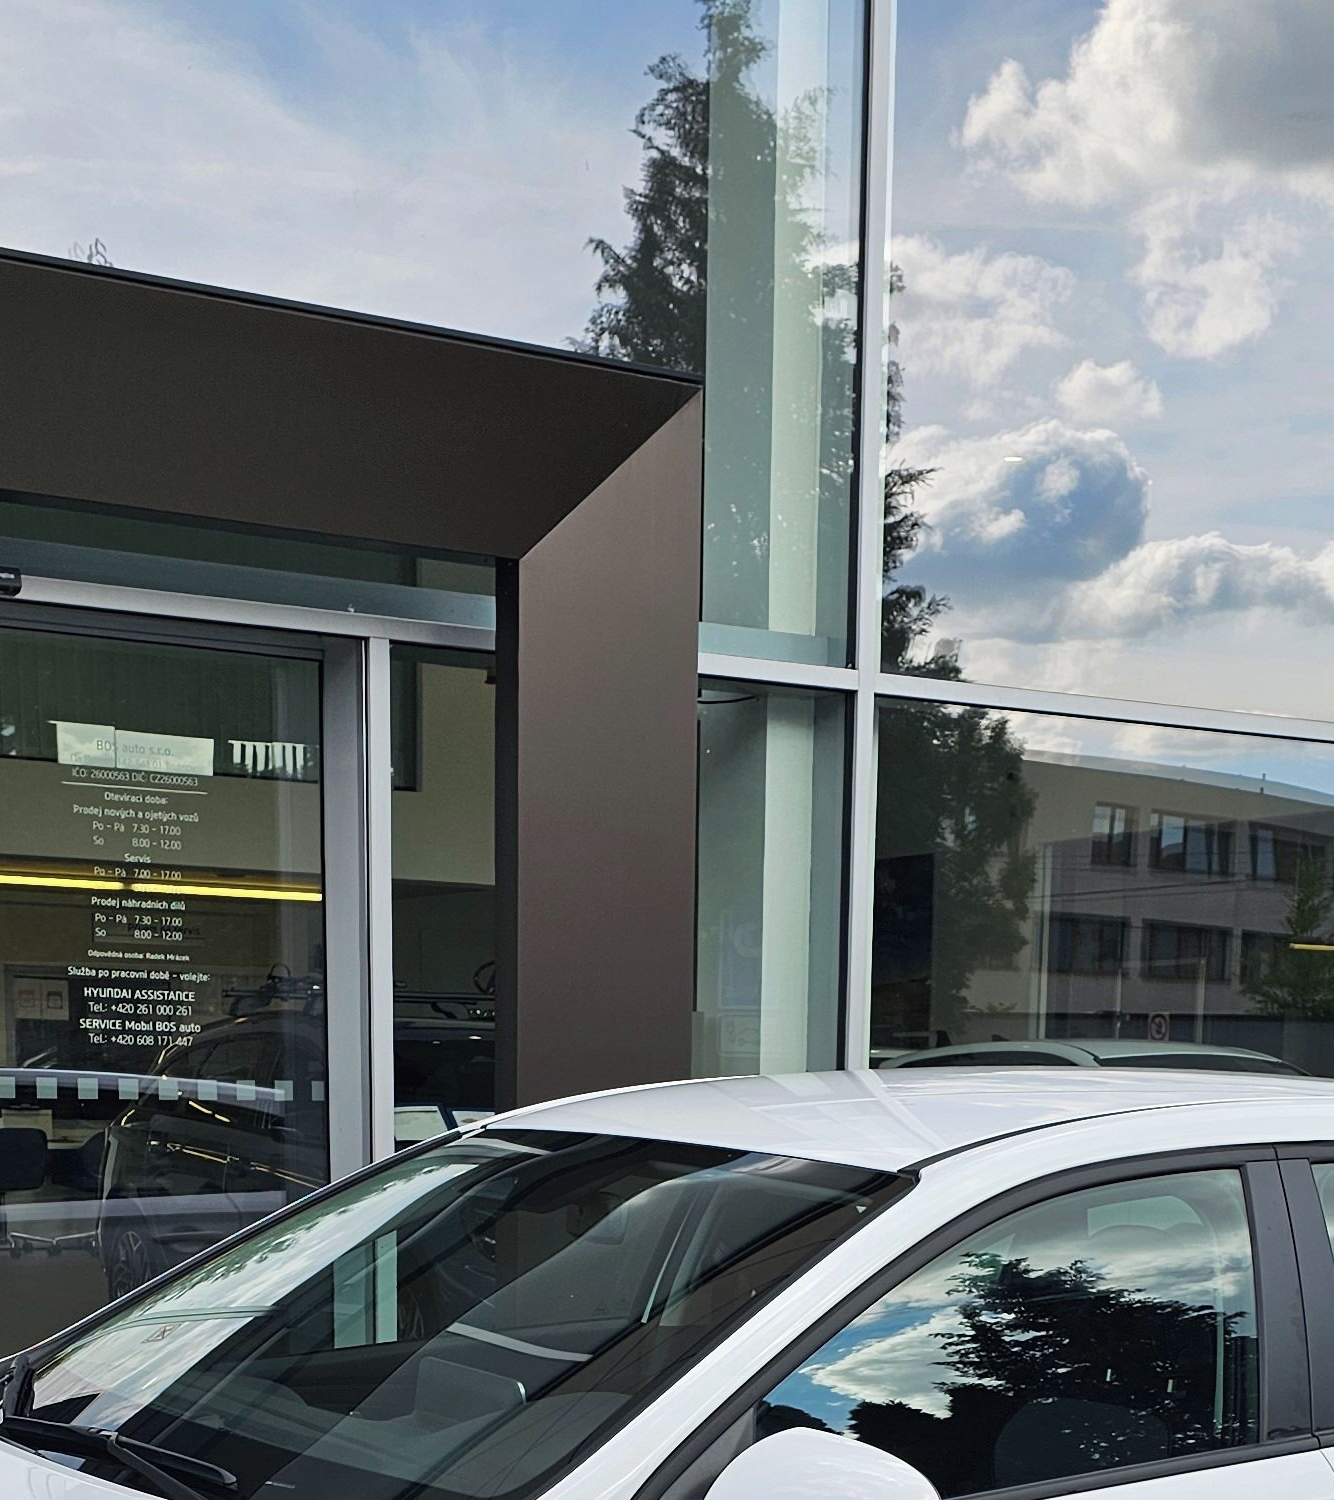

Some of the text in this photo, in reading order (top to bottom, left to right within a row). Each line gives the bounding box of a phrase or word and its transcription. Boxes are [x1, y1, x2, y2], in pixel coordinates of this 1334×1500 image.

[73, 804, 199, 822] Prodej nových a ojetých vozů
[92, 821, 104, 831] Po
[114, 822, 125, 832] Pá
[132, 823, 149, 834] 7.30
[160, 825, 181, 836] 17.00
[93, 835, 104, 845] So
[132, 838, 150, 848] 8.00
[160, 840, 181, 850] 12.00
[124, 853, 151, 863] Servis
[94, 866, 105, 876] Po
[115, 867, 126, 878] Pá
[133, 868, 151, 879] 7.00
[91, 896, 119, 909] Prodej
[94, 913, 106, 922] Po
[115, 914, 127, 924] Pá
[134, 915, 151, 925] 7.30
[161, 916, 183, 927] 17.00
[94, 927, 106, 937] So
[134, 930, 152, 939] 8.00
[161, 931, 183, 941] 12.00
[68, 965, 96, 977] Služba
[98, 969, 109, 979] po
[149, 970, 170, 980] době
[180, 972, 210, 983] volejte:
[83, 986, 196, 1002] HYUNDAI ASSISTANCE
[110, 1003, 134, 1013] +420
[136, 1004, 153, 1014] 261
[156, 1004, 173, 1015] 000
[175, 1005, 192, 1016] 261
[79, 1018, 202, 1033] SERVICE Mobil BOS auto
[110, 1034, 134, 1045] +420
[136, 1035, 154, 1046] 608
